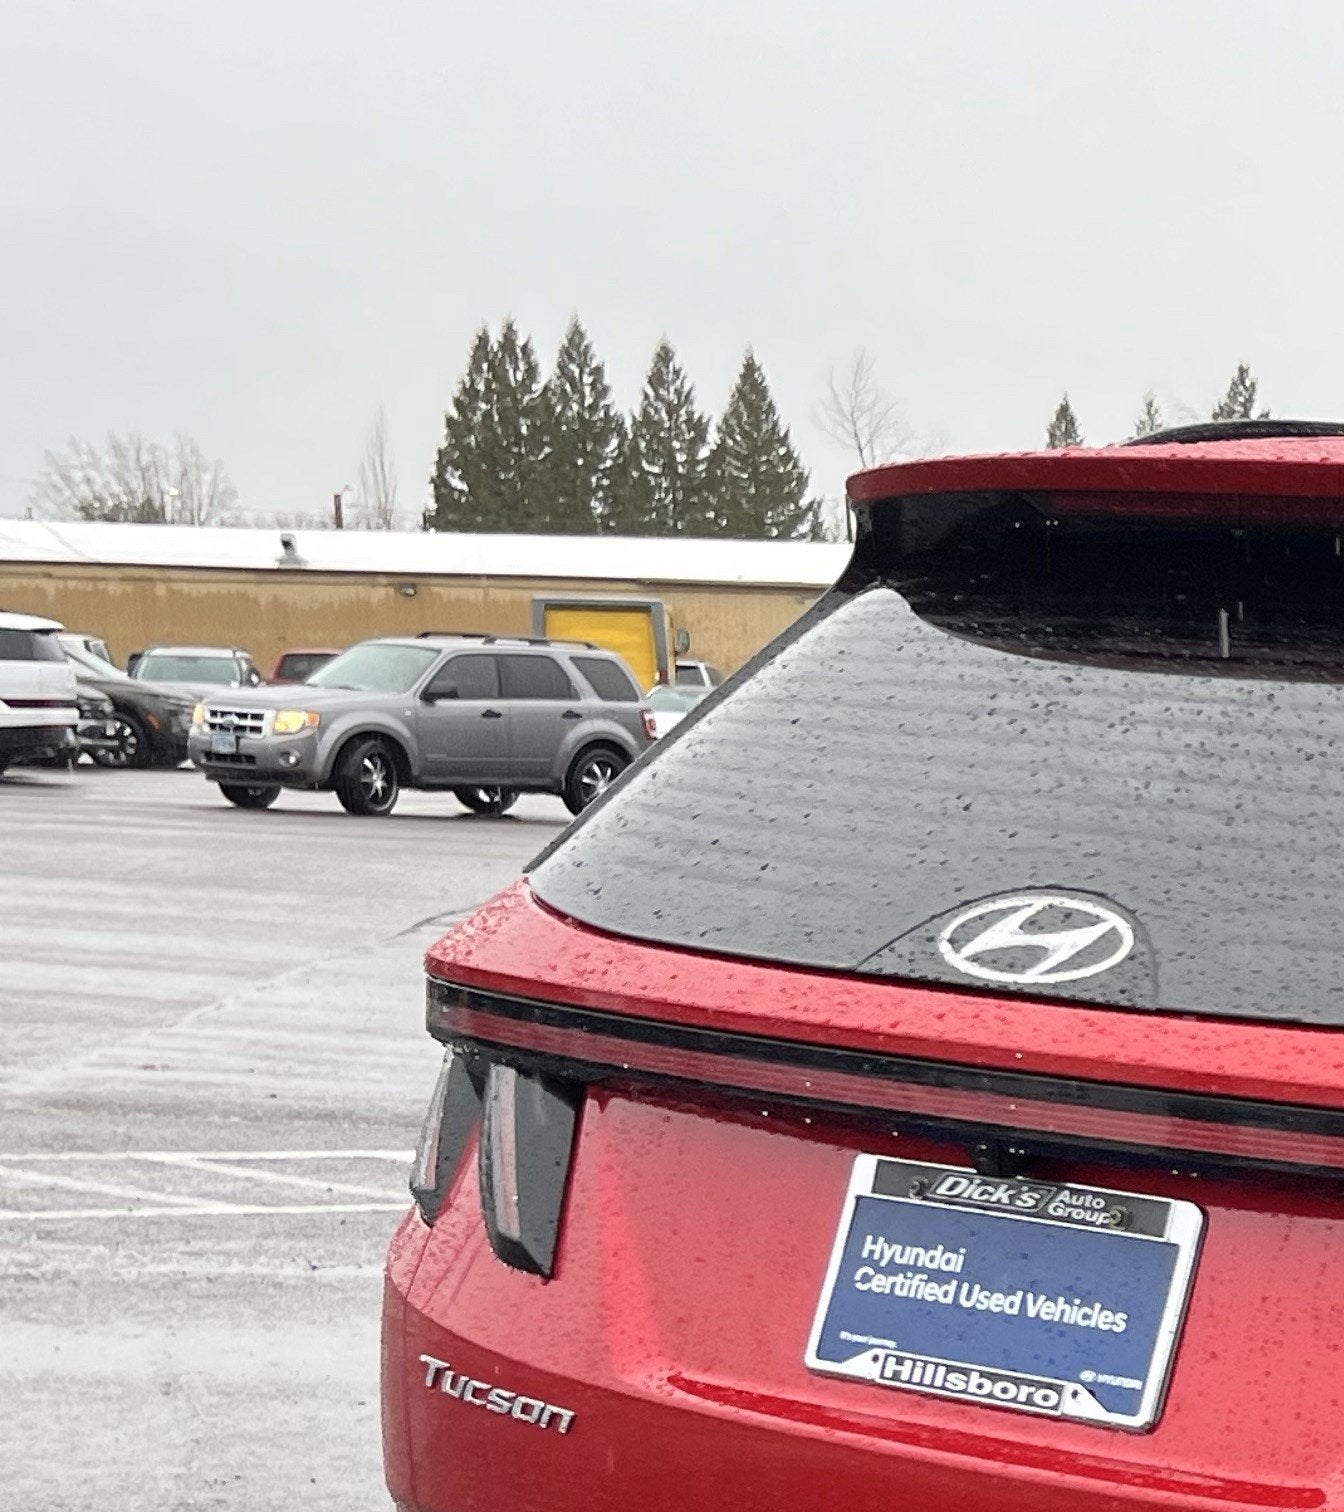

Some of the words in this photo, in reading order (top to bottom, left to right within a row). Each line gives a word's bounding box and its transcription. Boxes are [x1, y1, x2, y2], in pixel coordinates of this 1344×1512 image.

[935, 1175, 1042, 1209] Dick's
[1054, 1189, 1106, 1209] Auto
[1047, 1202, 1113, 1226] Group
[861, 1234, 967, 1273] Hyundai
[854, 1266, 958, 1305] Certified
[959, 1281, 1024, 1316] Used
[1025, 1291, 1128, 1333] Vehicles
[882, 1355, 1060, 1407] Hillsboro
